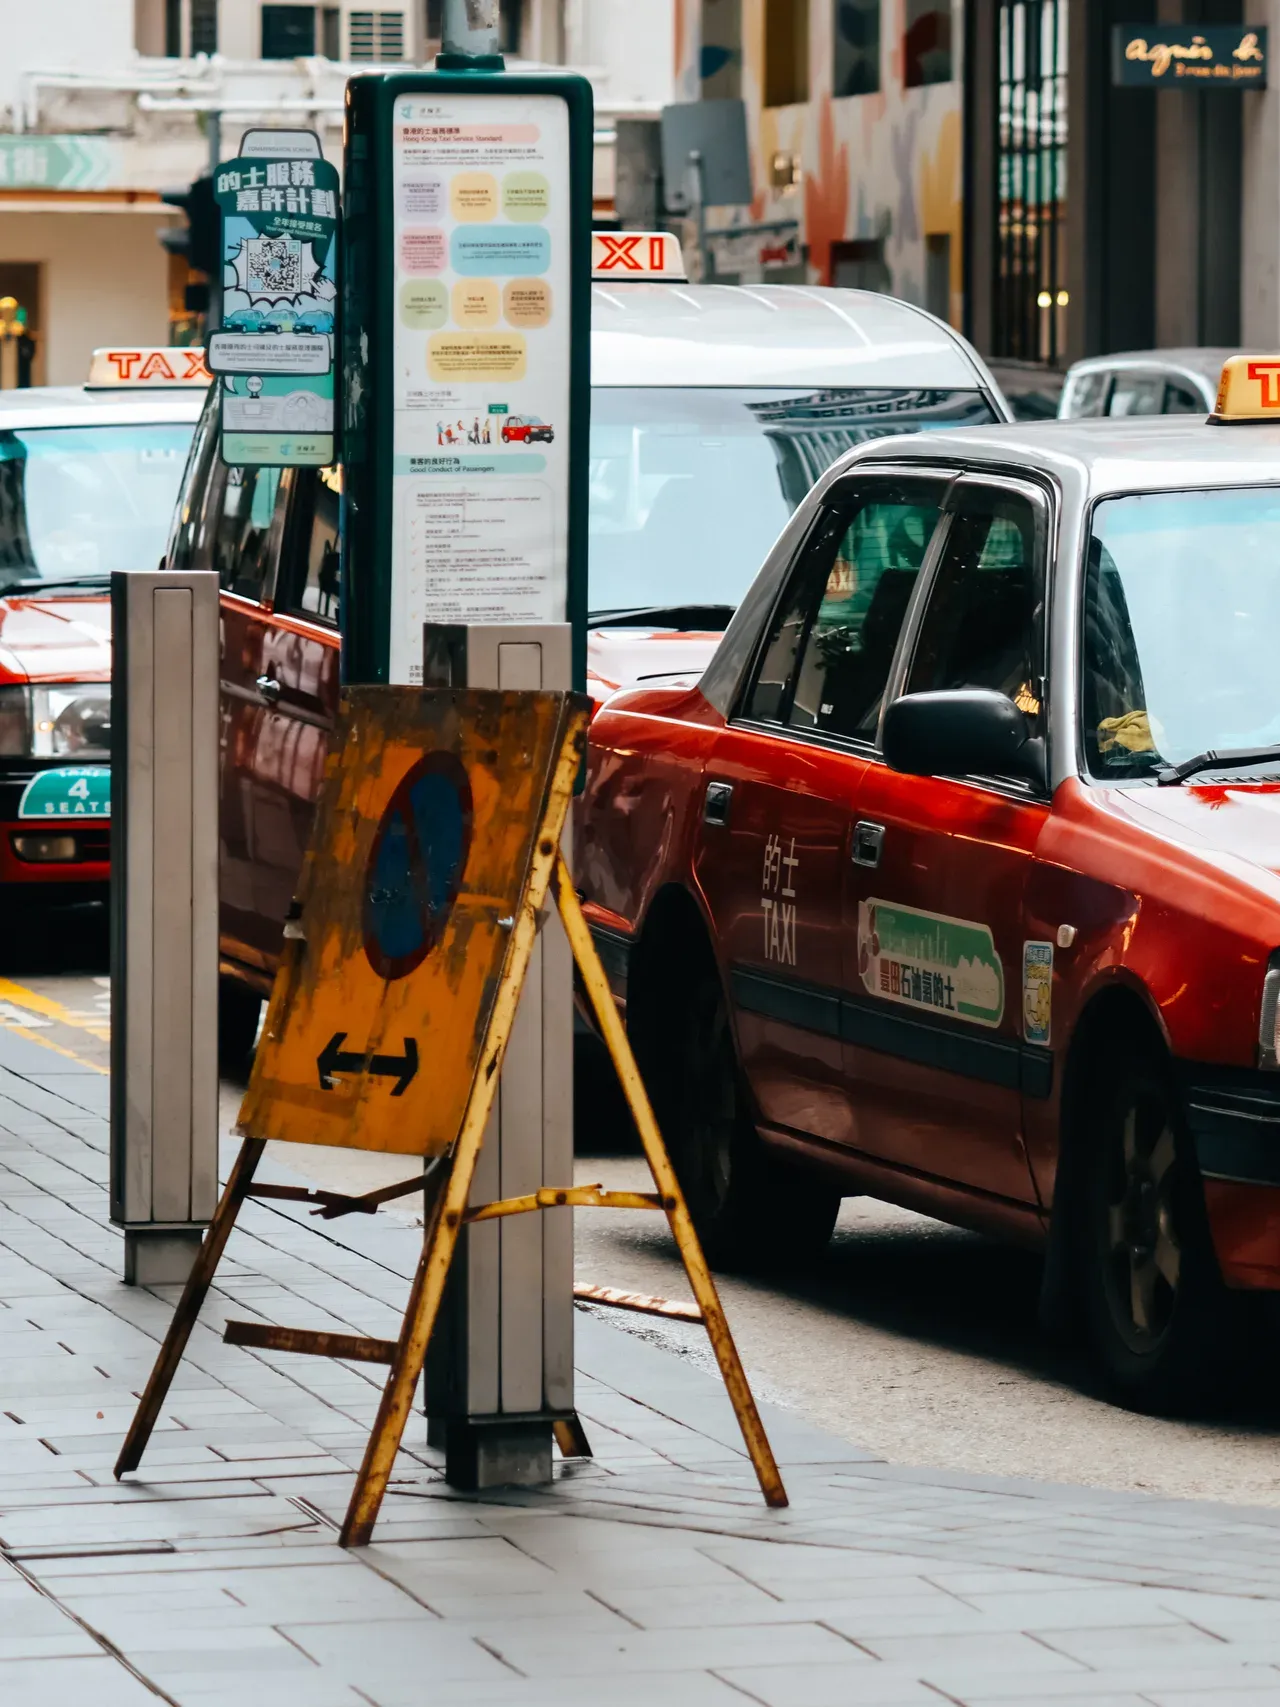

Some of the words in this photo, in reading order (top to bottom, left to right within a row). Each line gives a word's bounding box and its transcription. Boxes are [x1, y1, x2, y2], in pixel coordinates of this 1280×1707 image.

[217, 160, 315, 193] 的士服務
[236, 187, 336, 219] 嘉許計劃
[596, 236, 663, 270] XI
[107, 352, 214, 379] TAX
[67, 778, 91, 800] 4
[762, 834, 799, 897] 的士
[761, 897, 796, 966] TAXI
